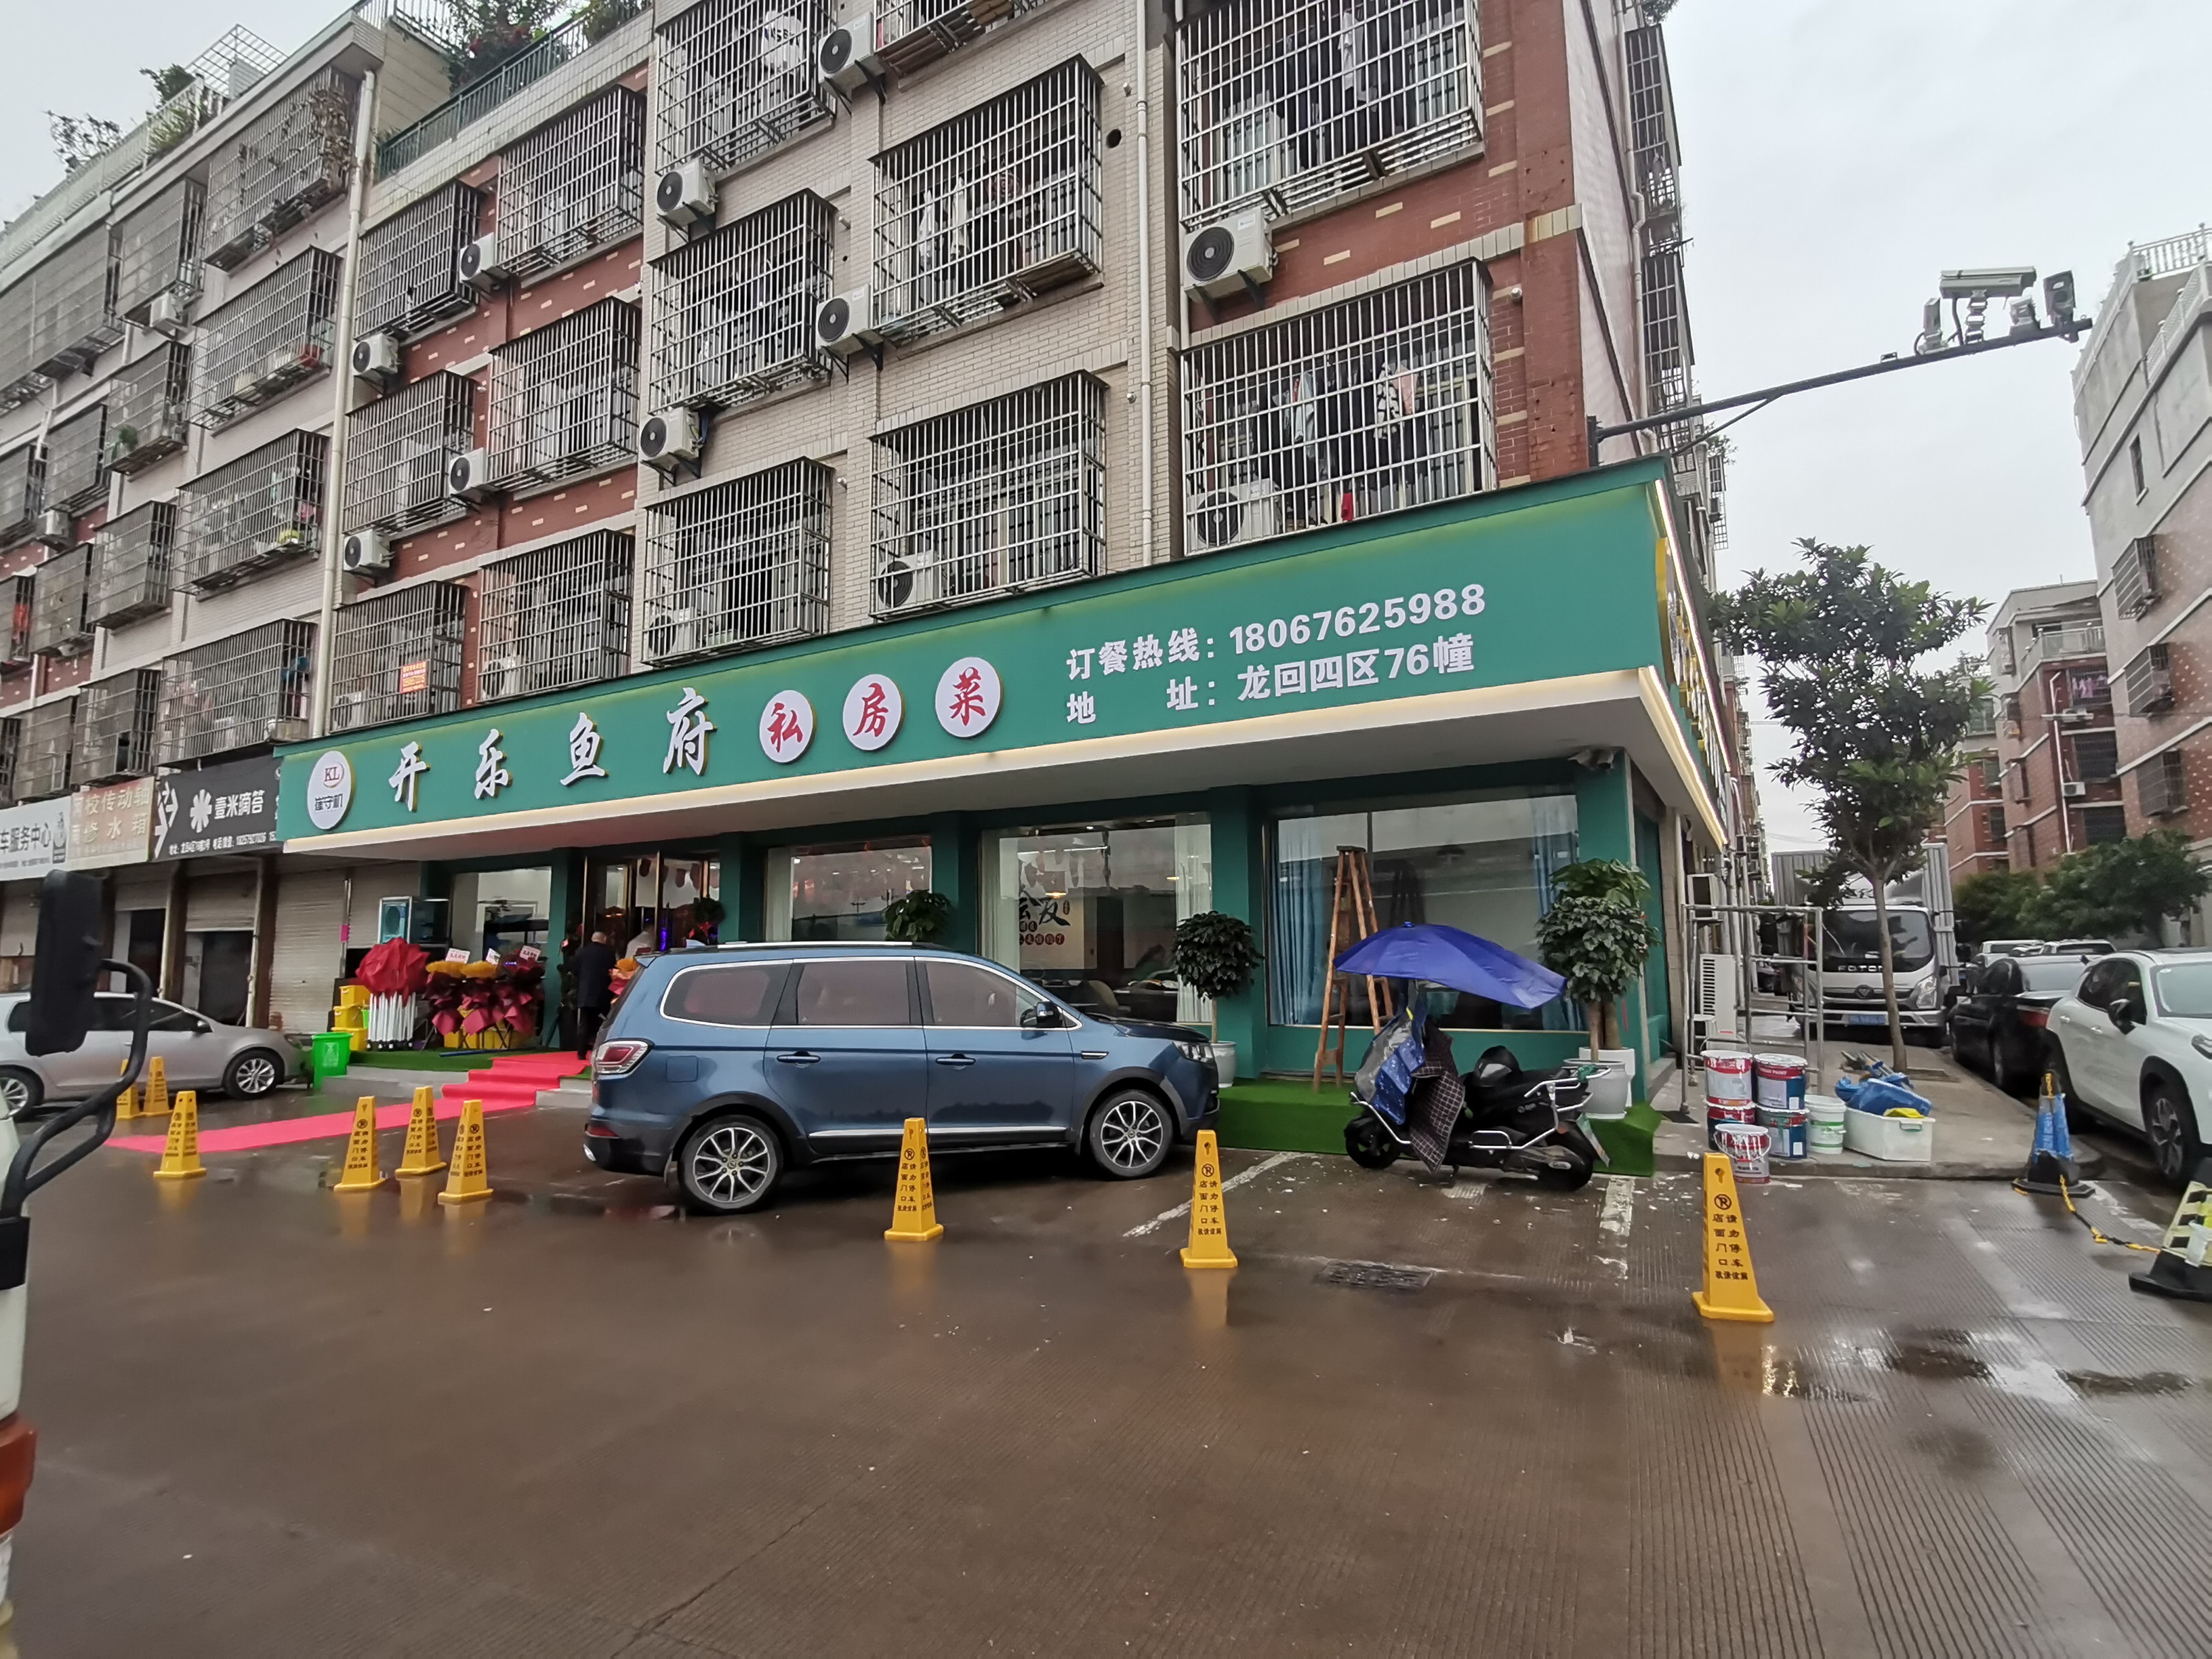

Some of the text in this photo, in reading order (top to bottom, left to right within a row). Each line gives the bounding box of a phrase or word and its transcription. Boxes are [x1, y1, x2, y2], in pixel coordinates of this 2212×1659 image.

[1229, 583, 1485, 655] 18067625988
[1237, 633, 1475, 702] 龙回四区76幢
[767, 667, 986, 753] 私房菜
